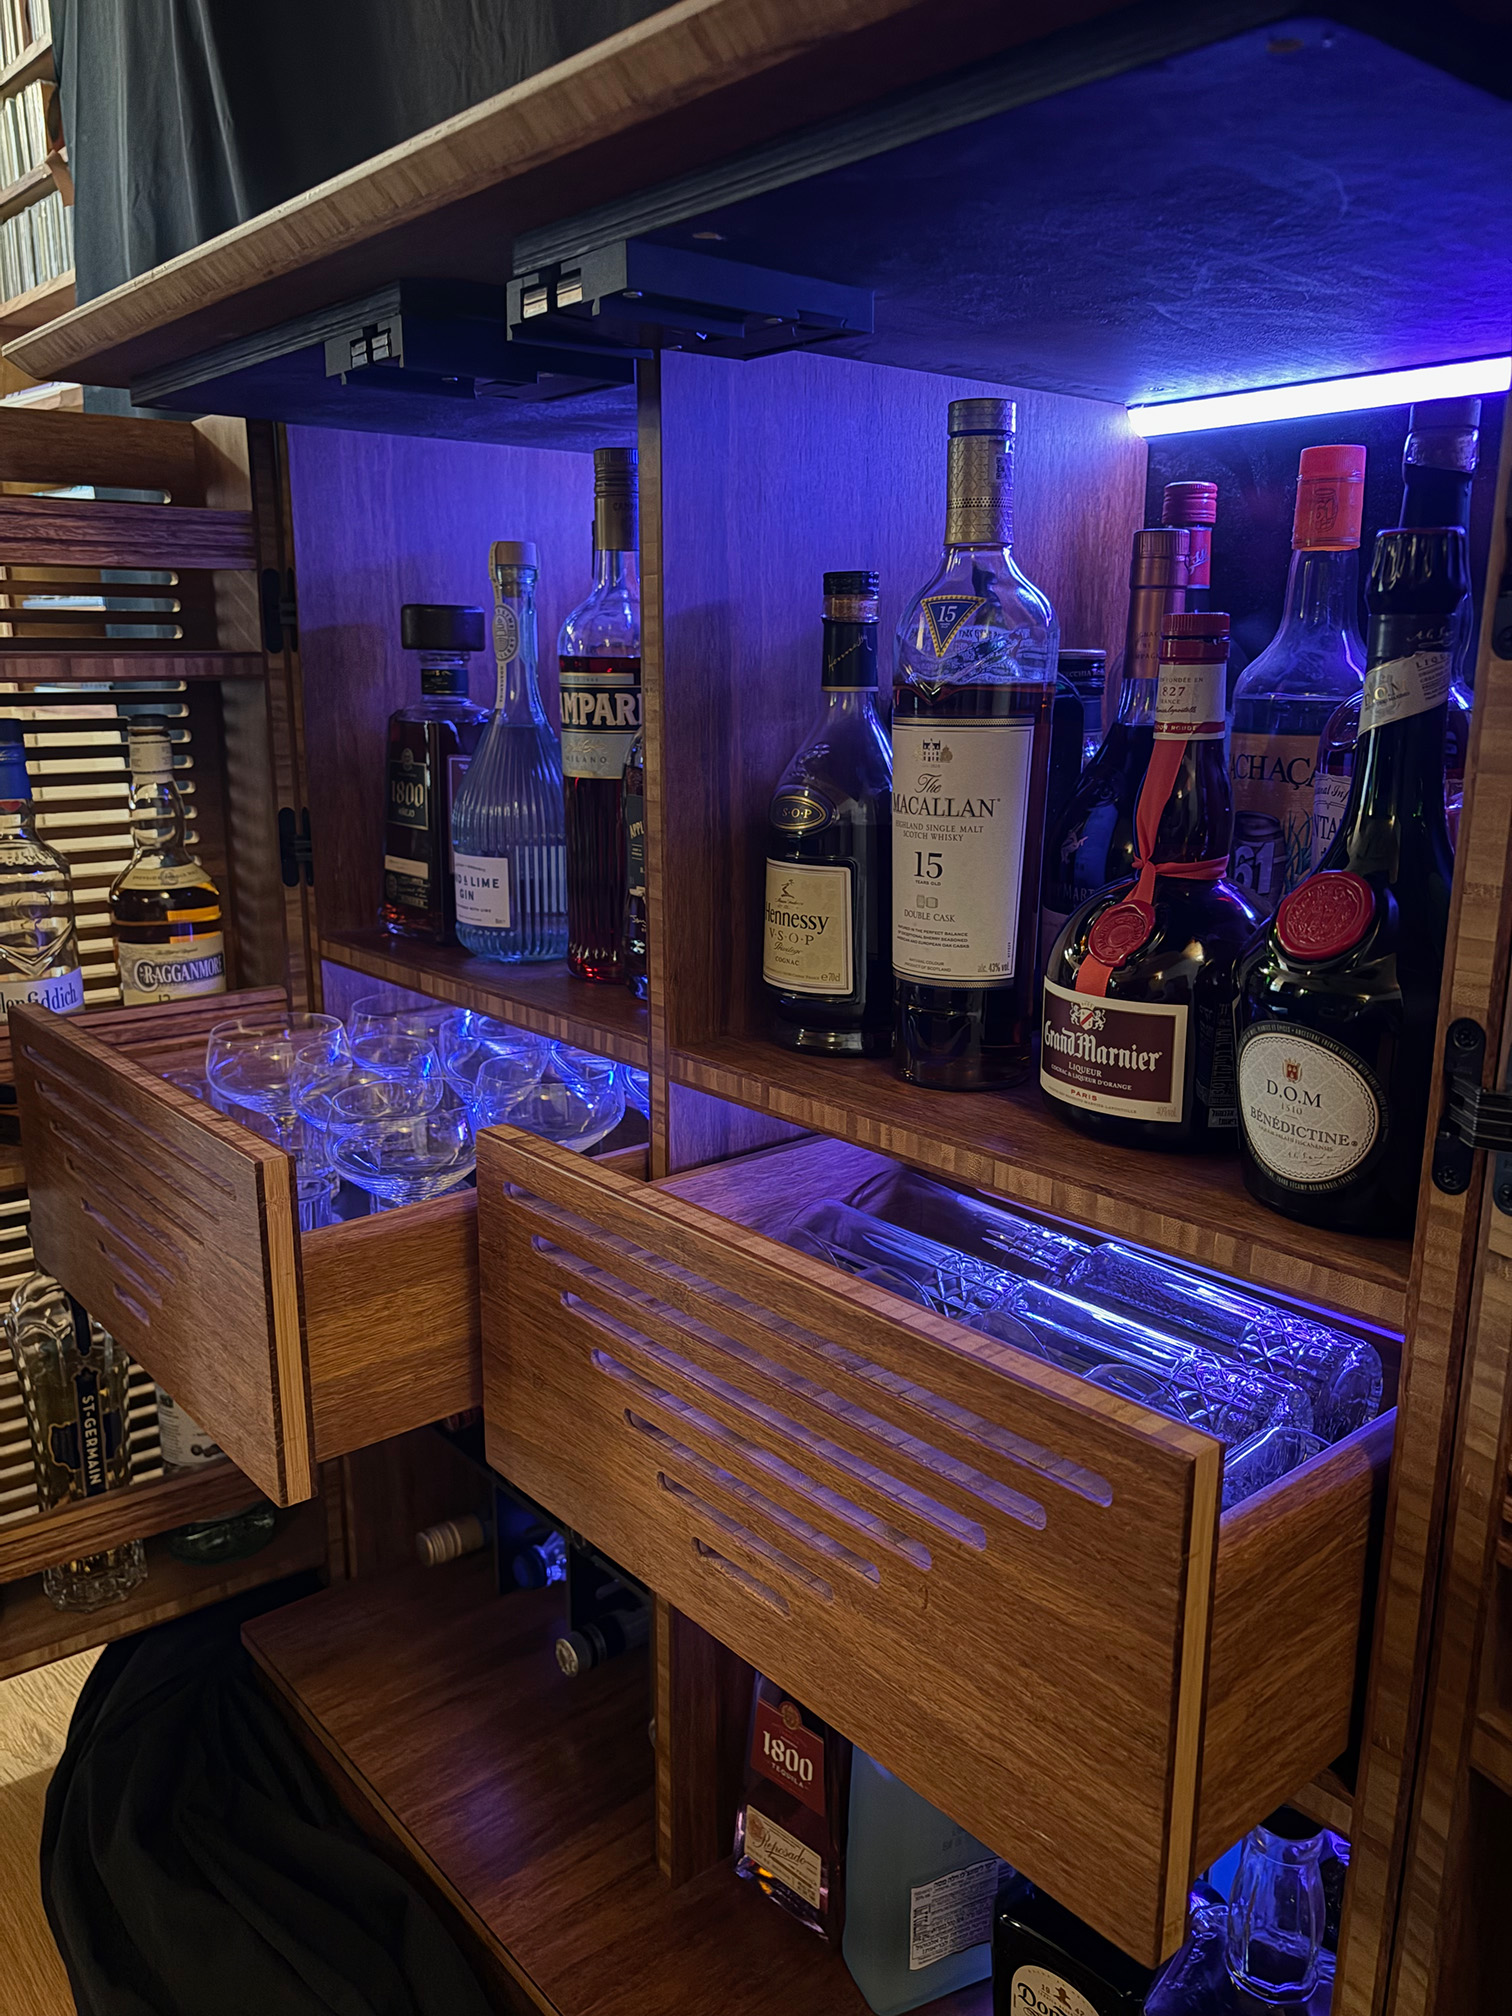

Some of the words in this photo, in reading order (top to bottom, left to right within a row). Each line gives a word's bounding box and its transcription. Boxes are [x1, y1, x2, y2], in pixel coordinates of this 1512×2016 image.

[939, 605, 959, 622] 15
[914, 773, 943, 794] The
[391, 780, 425, 809] 1800
[893, 792, 996, 819] MACALLAN
[903, 831, 928, 840] SCOTCH
[931, 833, 964, 843] WHISKY
[926, 823, 955, 833] SINGLE
[960, 825, 984, 834] MALT
[914, 851, 943, 879] 15
[470, 875, 500, 889] LIME
[459, 888, 474, 901] GIN
[765, 902, 830, 935] Hennessy
[904, 909, 931, 921] DOUBLE
[933, 913, 956, 923] CASK
[775, 955, 800, 966] COGNAC
[134, 955, 224, 993] CRAGGANMORE
[1044, 1019, 1080, 1057] Grand
[1074, 1032, 1163, 1072] Marnier
[1068, 1061, 1103, 1079] LIQUEUR
[1072, 1071, 1098, 1084] LIQUEUR
[1098, 1079, 1133, 1091] D'ORANGE
[1070, 1089, 1097, 1102] PARIS
[1267, 1079, 1322, 1109] D.O.M
[1281, 1103, 1303, 1116] 1510
[763, 1730, 814, 1782] 1800
[770, 1760, 805, 1789] TEQUILA
